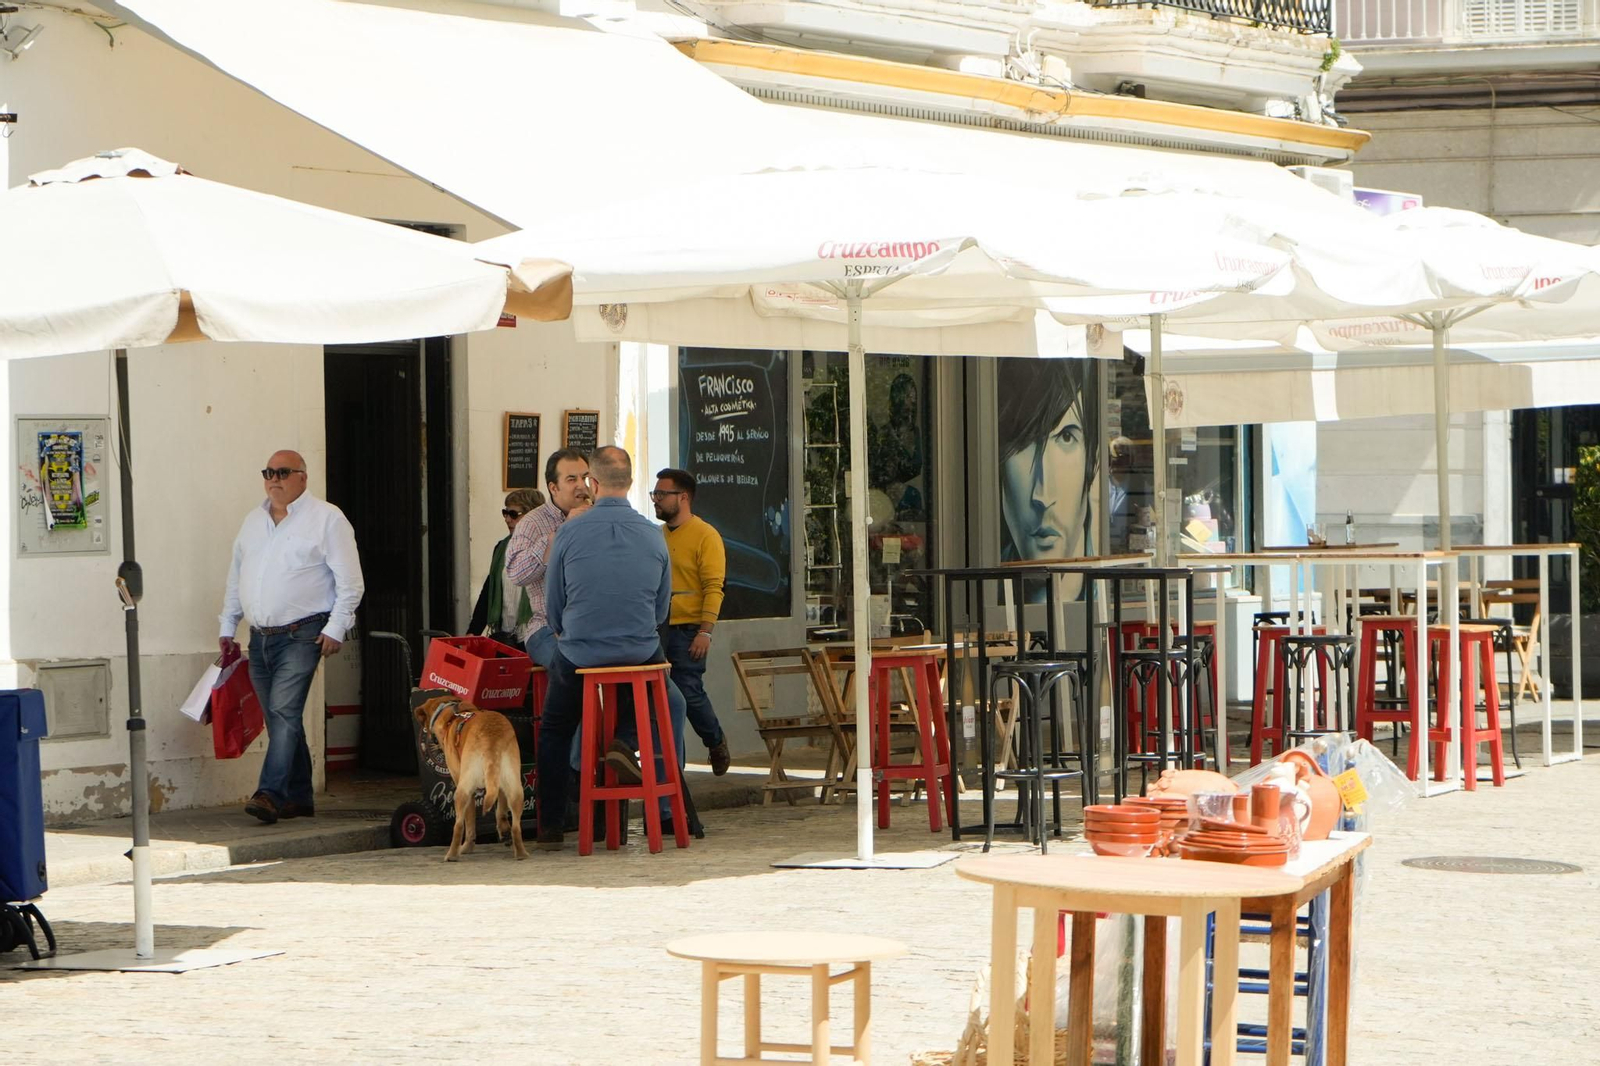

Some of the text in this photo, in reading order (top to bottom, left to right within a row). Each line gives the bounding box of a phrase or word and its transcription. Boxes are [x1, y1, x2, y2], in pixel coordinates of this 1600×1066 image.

[817, 240, 940, 262] Cruzcampo
[704, 403, 719, 415] ALTA
[696, 431, 715, 442] DESDE
[718, 422, 735, 445] 1995
[737, 431, 744, 441] AL
[695, 452, 704, 464] DE
[429, 672, 469, 696] Cruzcampo
[481, 687, 522, 700] Cruzcampo
